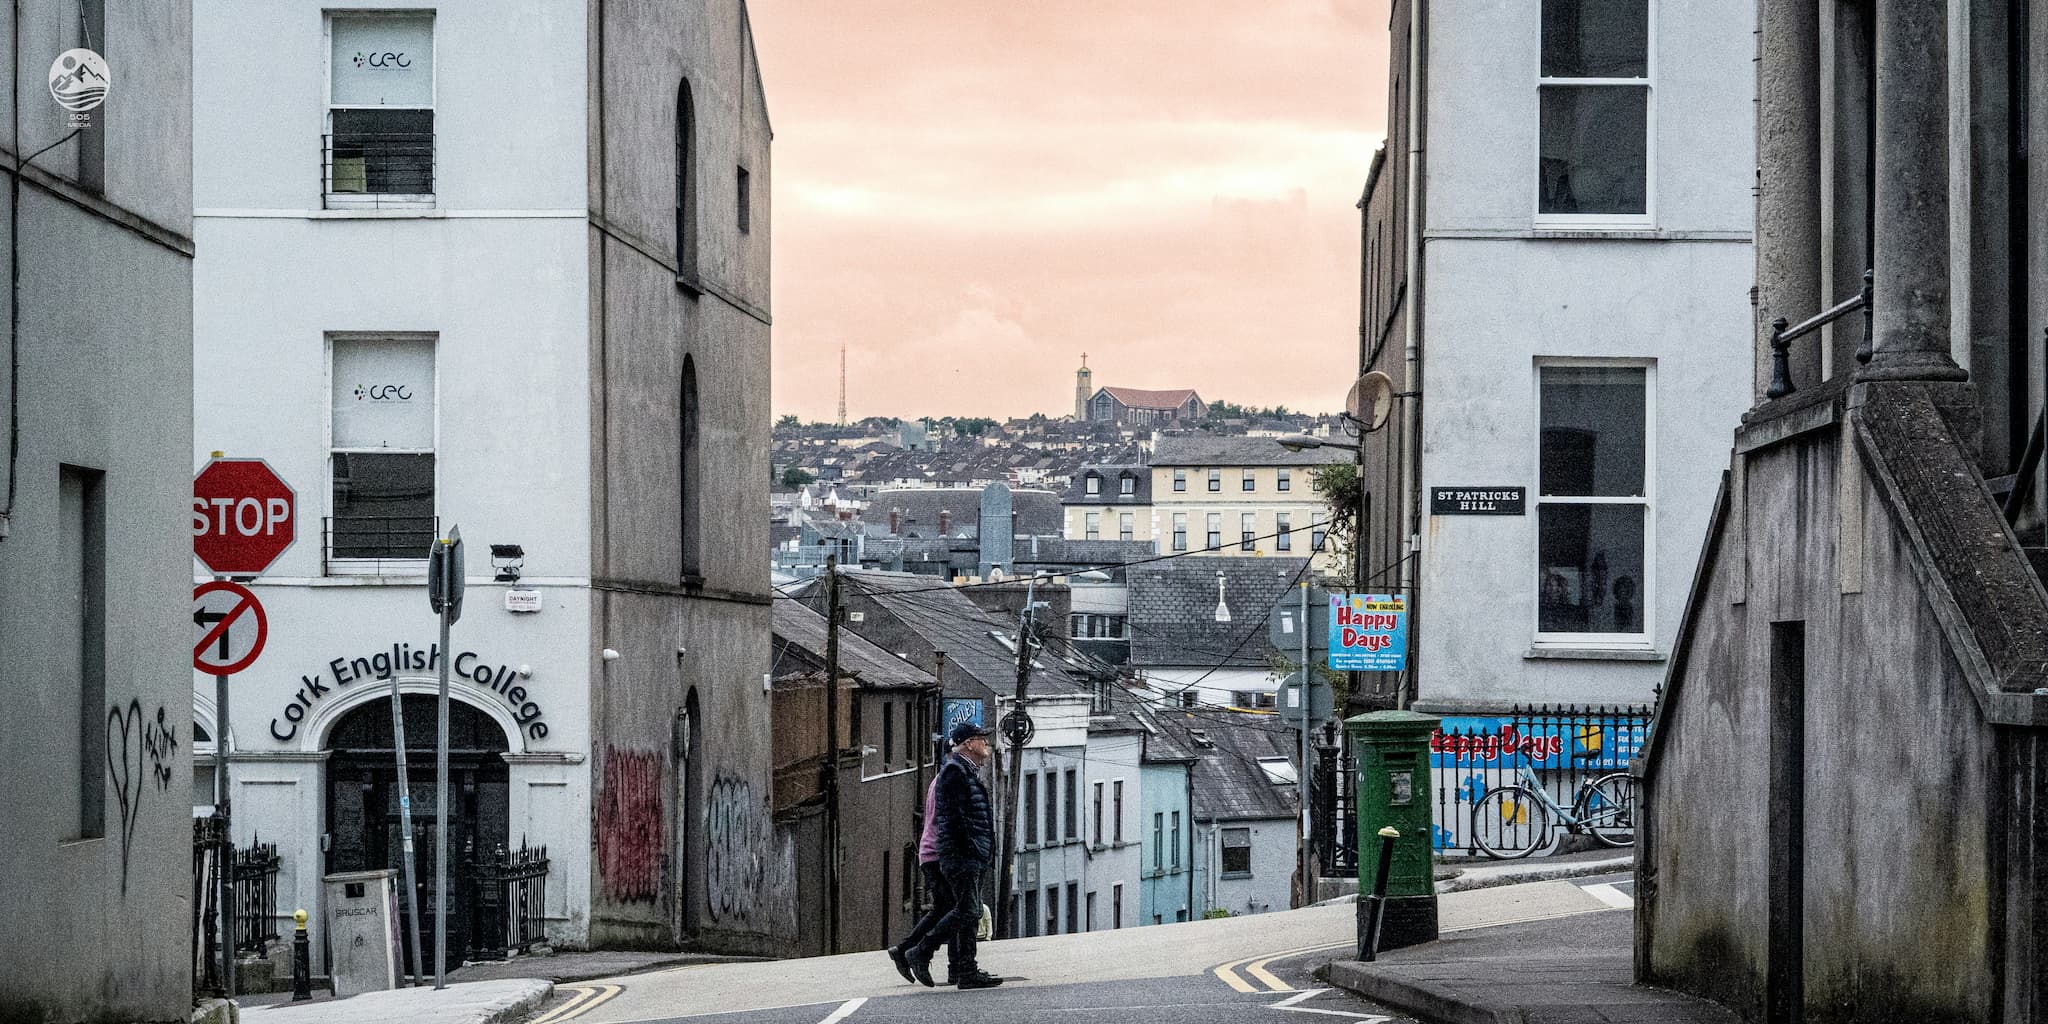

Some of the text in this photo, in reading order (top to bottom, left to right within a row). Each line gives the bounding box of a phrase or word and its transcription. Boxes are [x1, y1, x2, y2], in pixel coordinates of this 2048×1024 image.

[1438, 491, 1519, 500] ST PATRICKS
[1460, 501, 1496, 510] HILL
[194, 497, 289, 536] STOP
[1337, 606, 1397, 630] Happy
[1342, 627, 1391, 652] Days
[270, 643, 549, 742] Cork English College
[1502, 724, 1563, 761] Days
[335, 907, 377, 917] BRUSCAR
